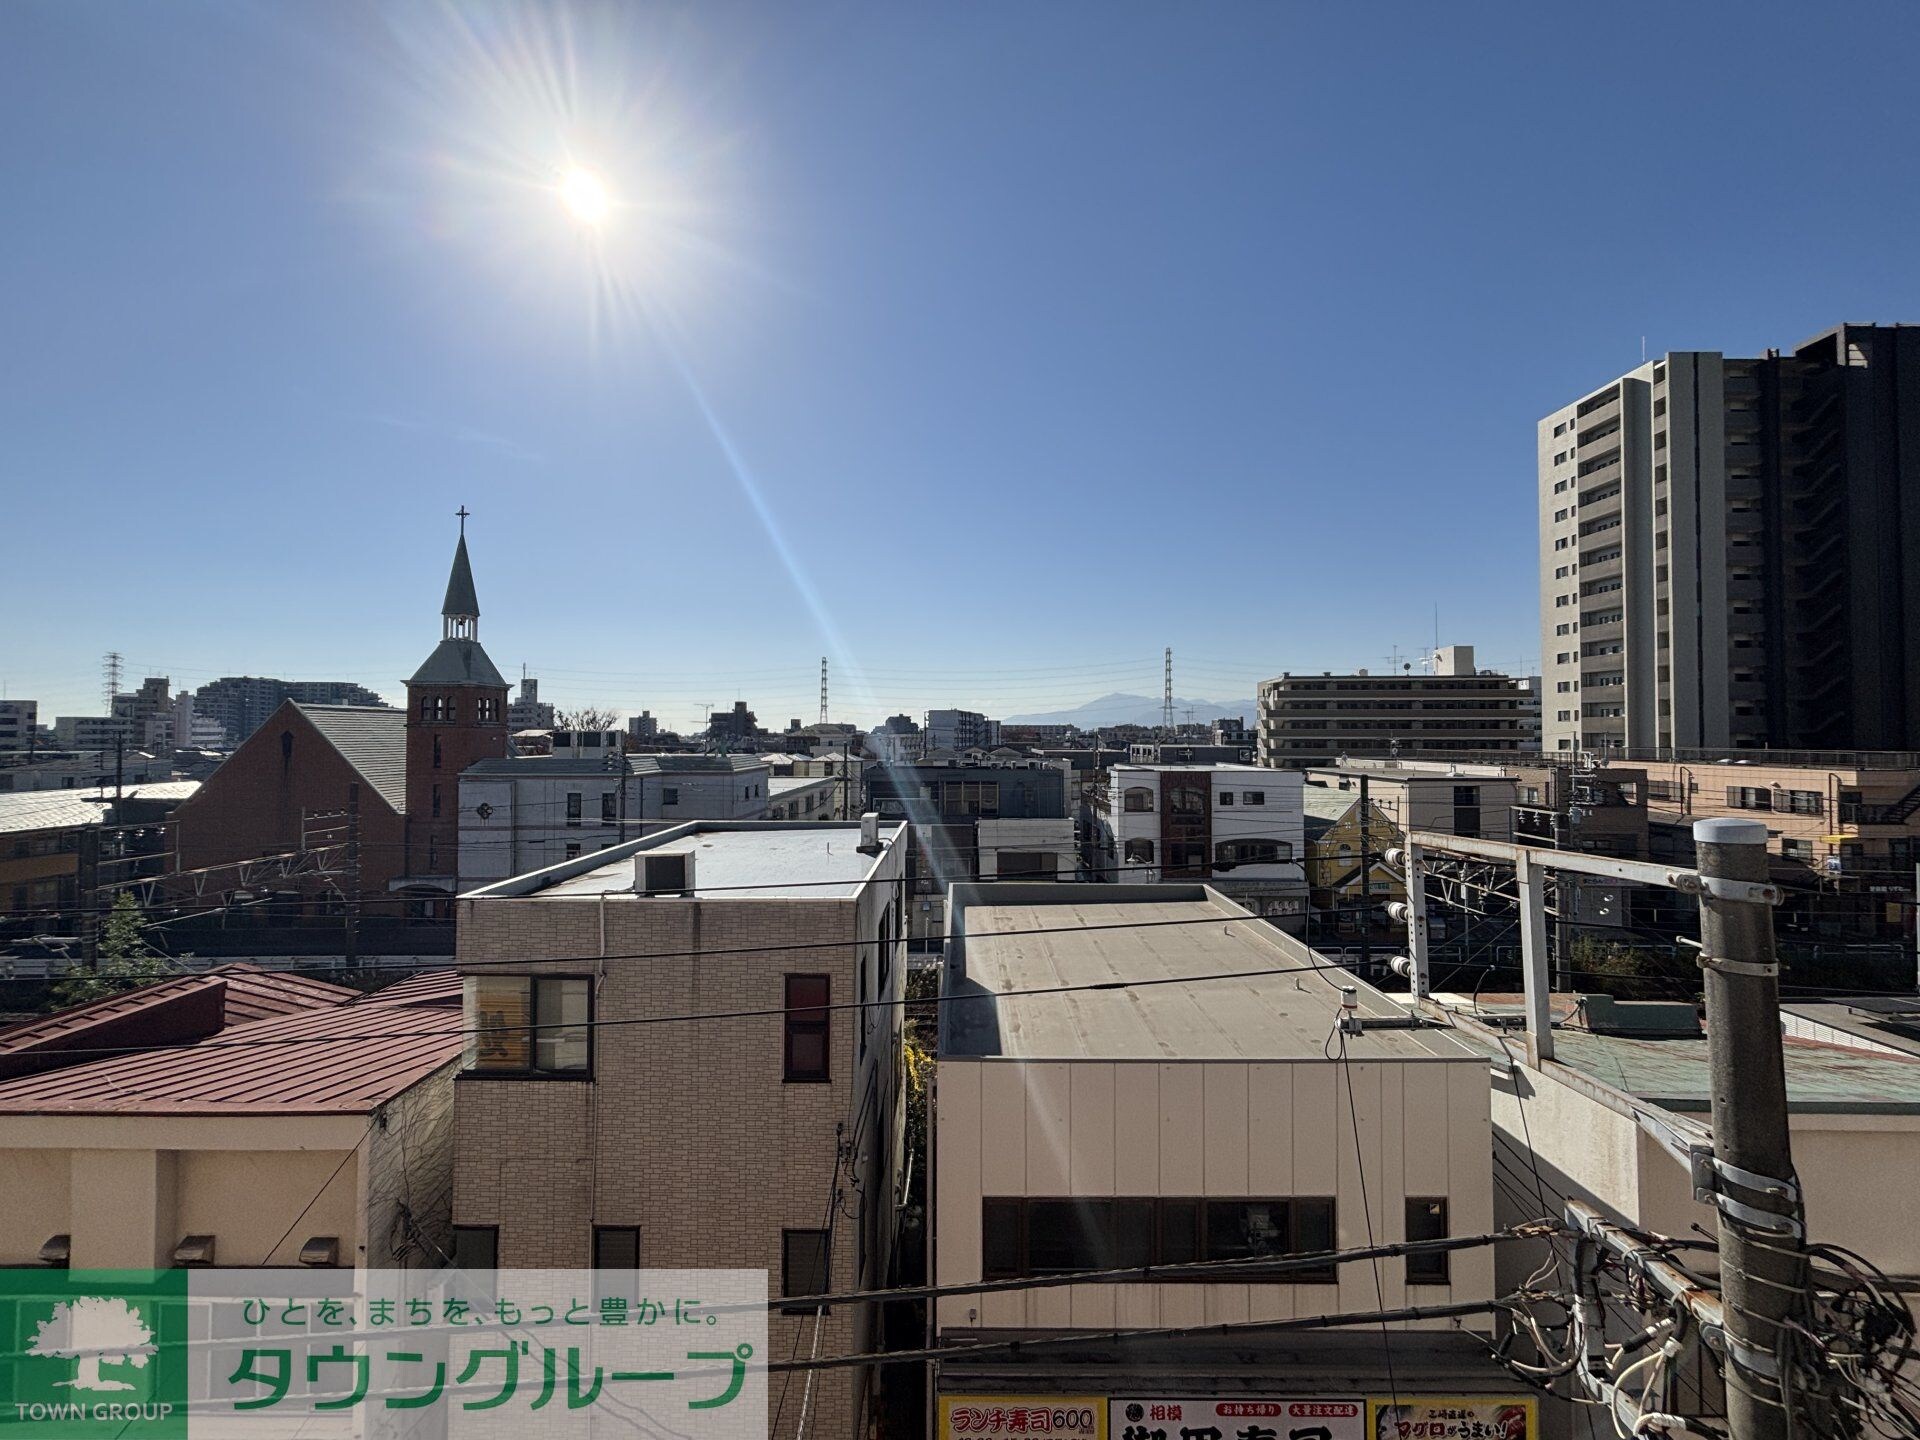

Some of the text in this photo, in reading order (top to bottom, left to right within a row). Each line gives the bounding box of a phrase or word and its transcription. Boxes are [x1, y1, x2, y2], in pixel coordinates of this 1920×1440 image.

[1150, 1404, 1183, 1421] 相模
[1222, 1404, 1276, 1416] お持ち帰り
